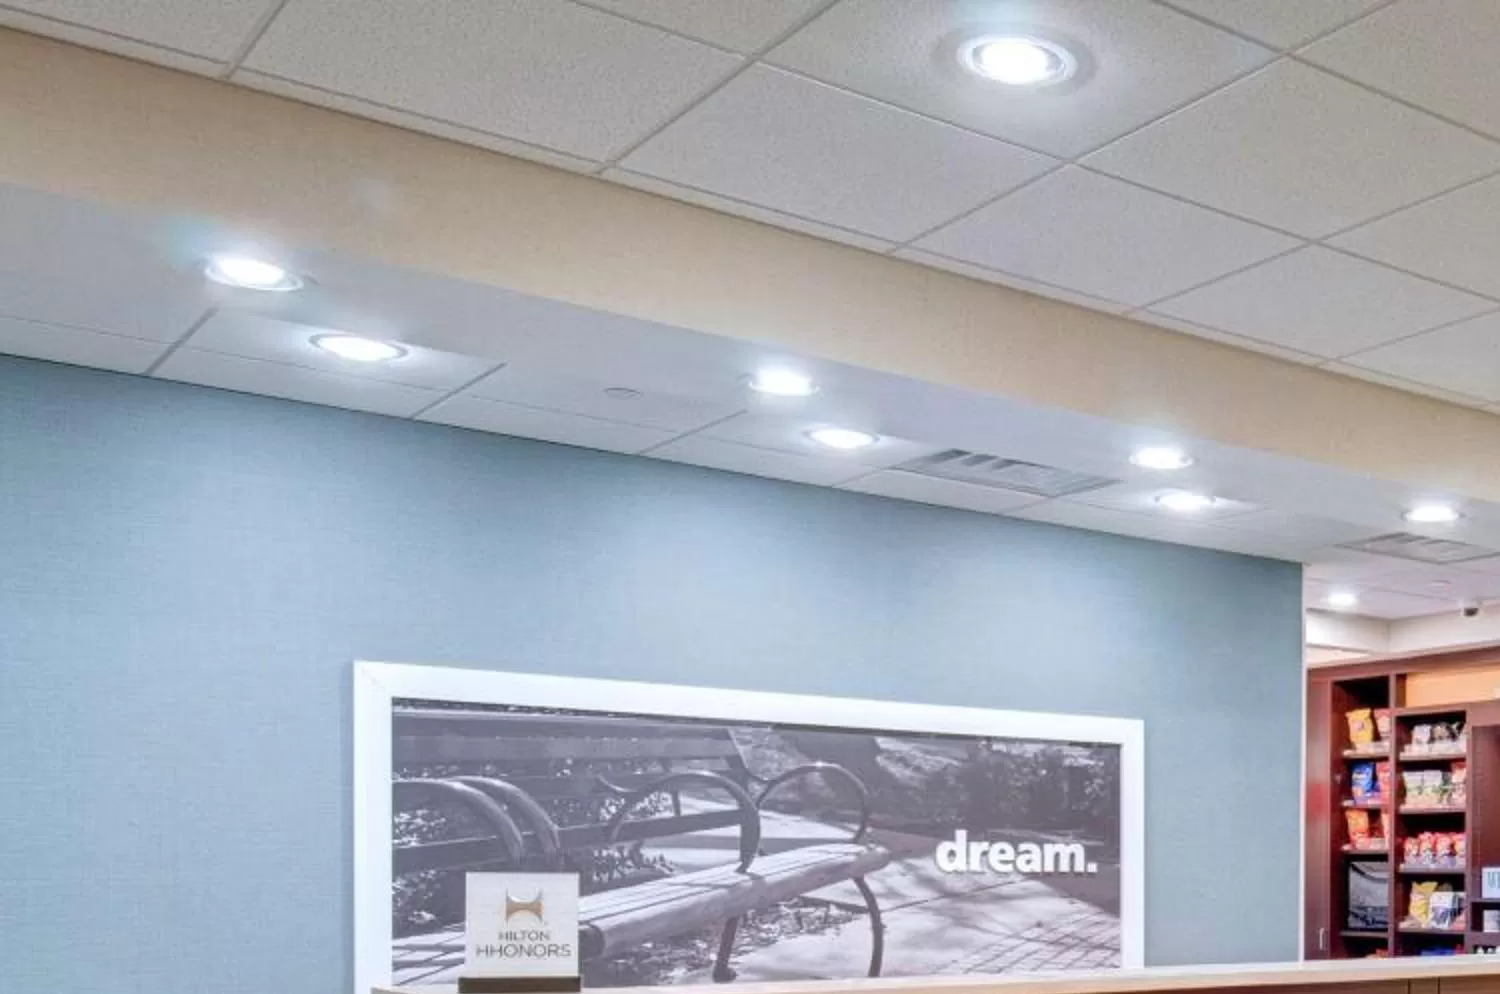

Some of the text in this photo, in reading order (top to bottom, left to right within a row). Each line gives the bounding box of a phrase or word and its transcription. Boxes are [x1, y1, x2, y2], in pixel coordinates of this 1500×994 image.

[935, 829, 1099, 873] dream.
[498, 930, 551, 942] HILTON
[475, 943, 572, 958] HHONORS
